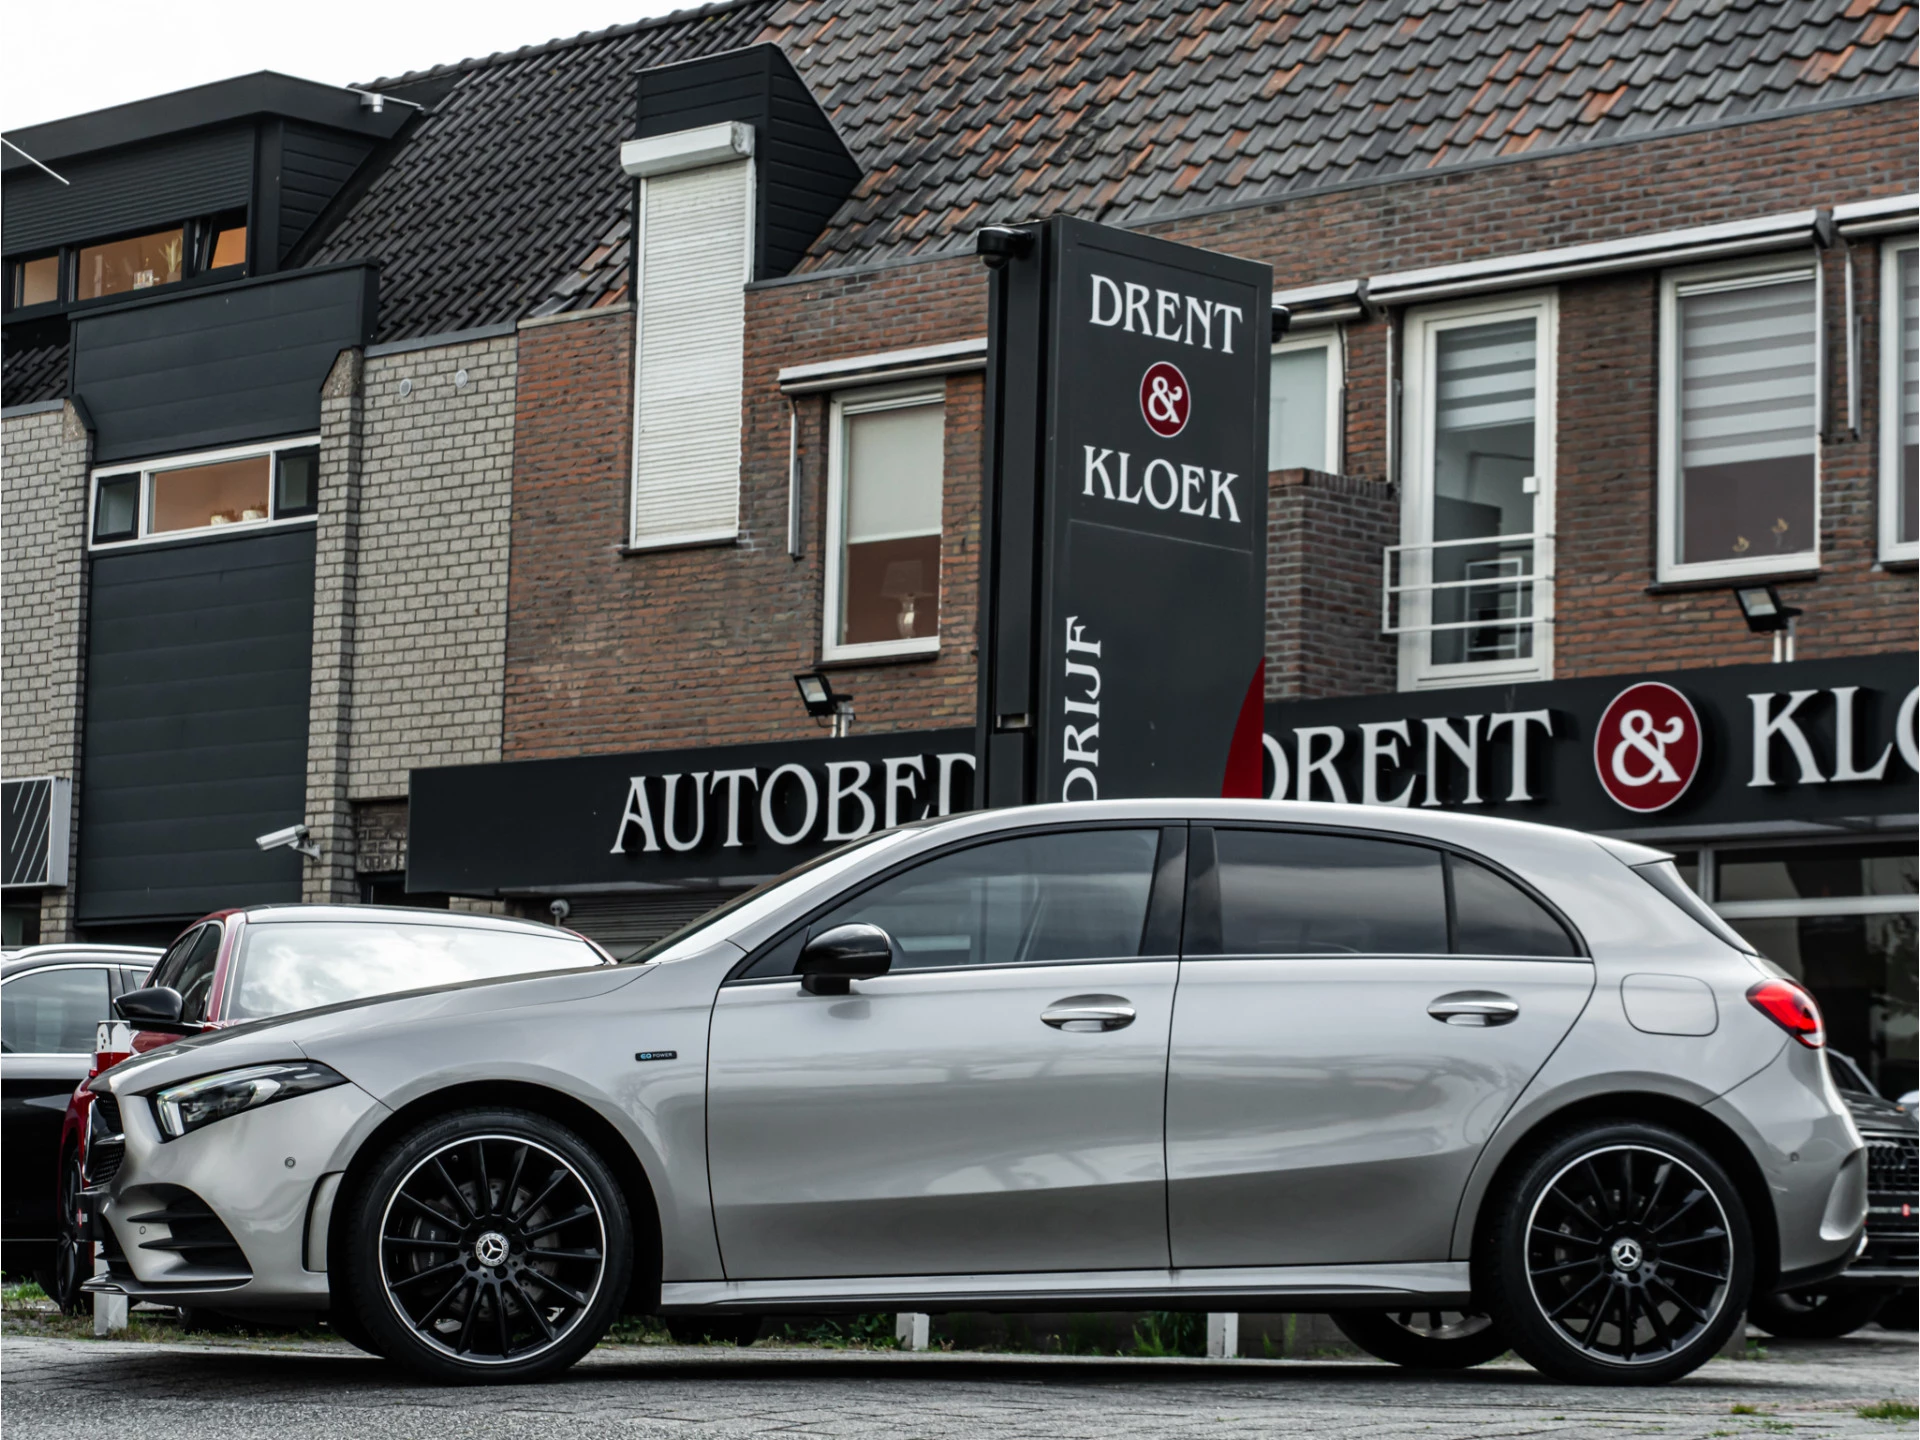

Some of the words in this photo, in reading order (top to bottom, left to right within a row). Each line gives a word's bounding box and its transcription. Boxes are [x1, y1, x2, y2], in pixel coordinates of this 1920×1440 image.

[1089, 273, 1243, 354] DRENT
[1147, 376, 1183, 424] &
[1082, 445, 1241, 523] KLOEK
[1611, 709, 1685, 787] &
